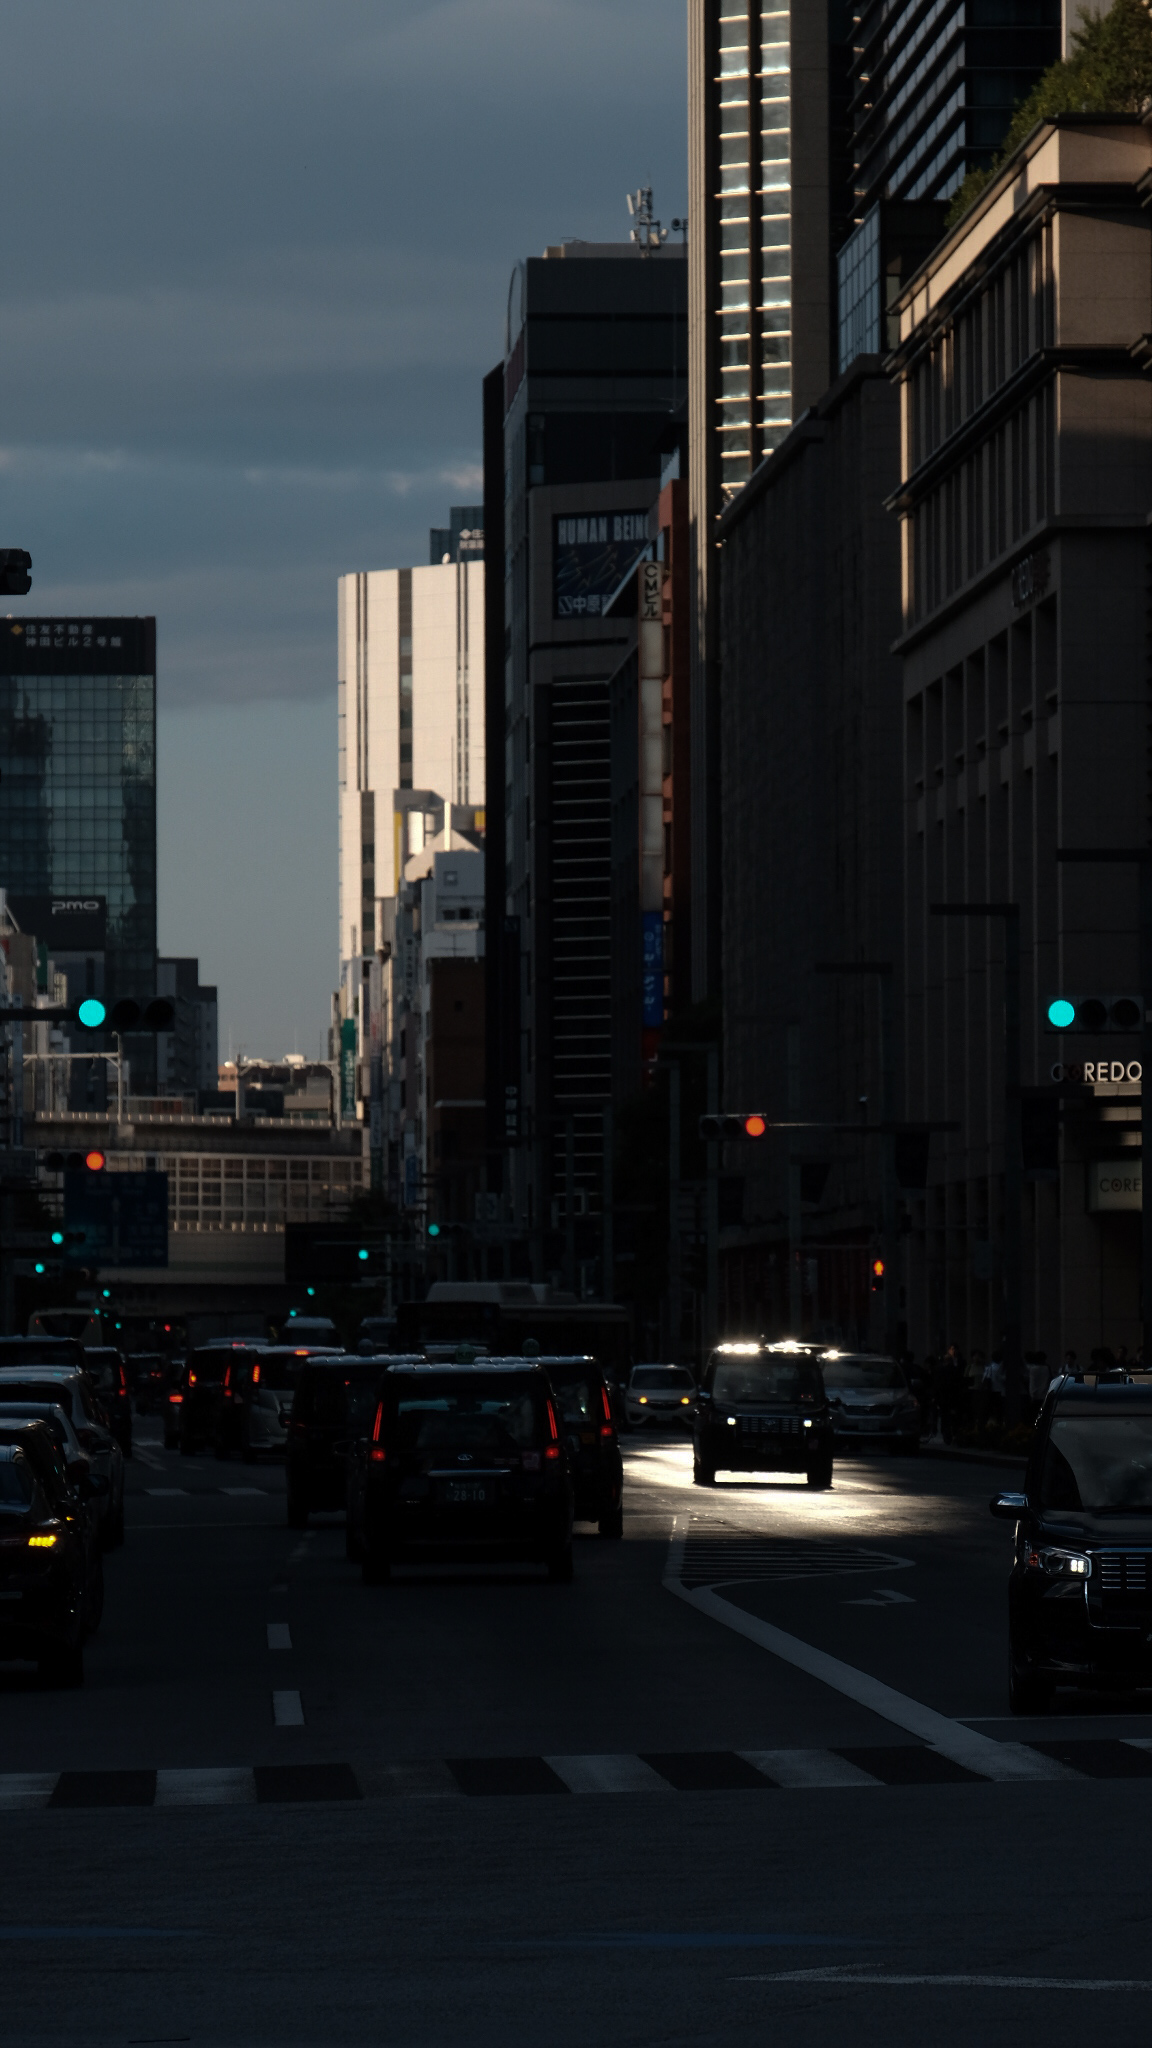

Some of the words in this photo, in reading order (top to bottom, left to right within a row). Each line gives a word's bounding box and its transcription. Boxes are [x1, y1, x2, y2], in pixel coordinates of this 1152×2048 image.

[558, 516, 607, 545] HUMAN
[644, 564, 660, 617] CMビル
[25, 624, 94, 636] 住友不動産
[25, 636, 122, 649] 神田ビル2号館
[1050, 1061, 1143, 1083] COREDO
